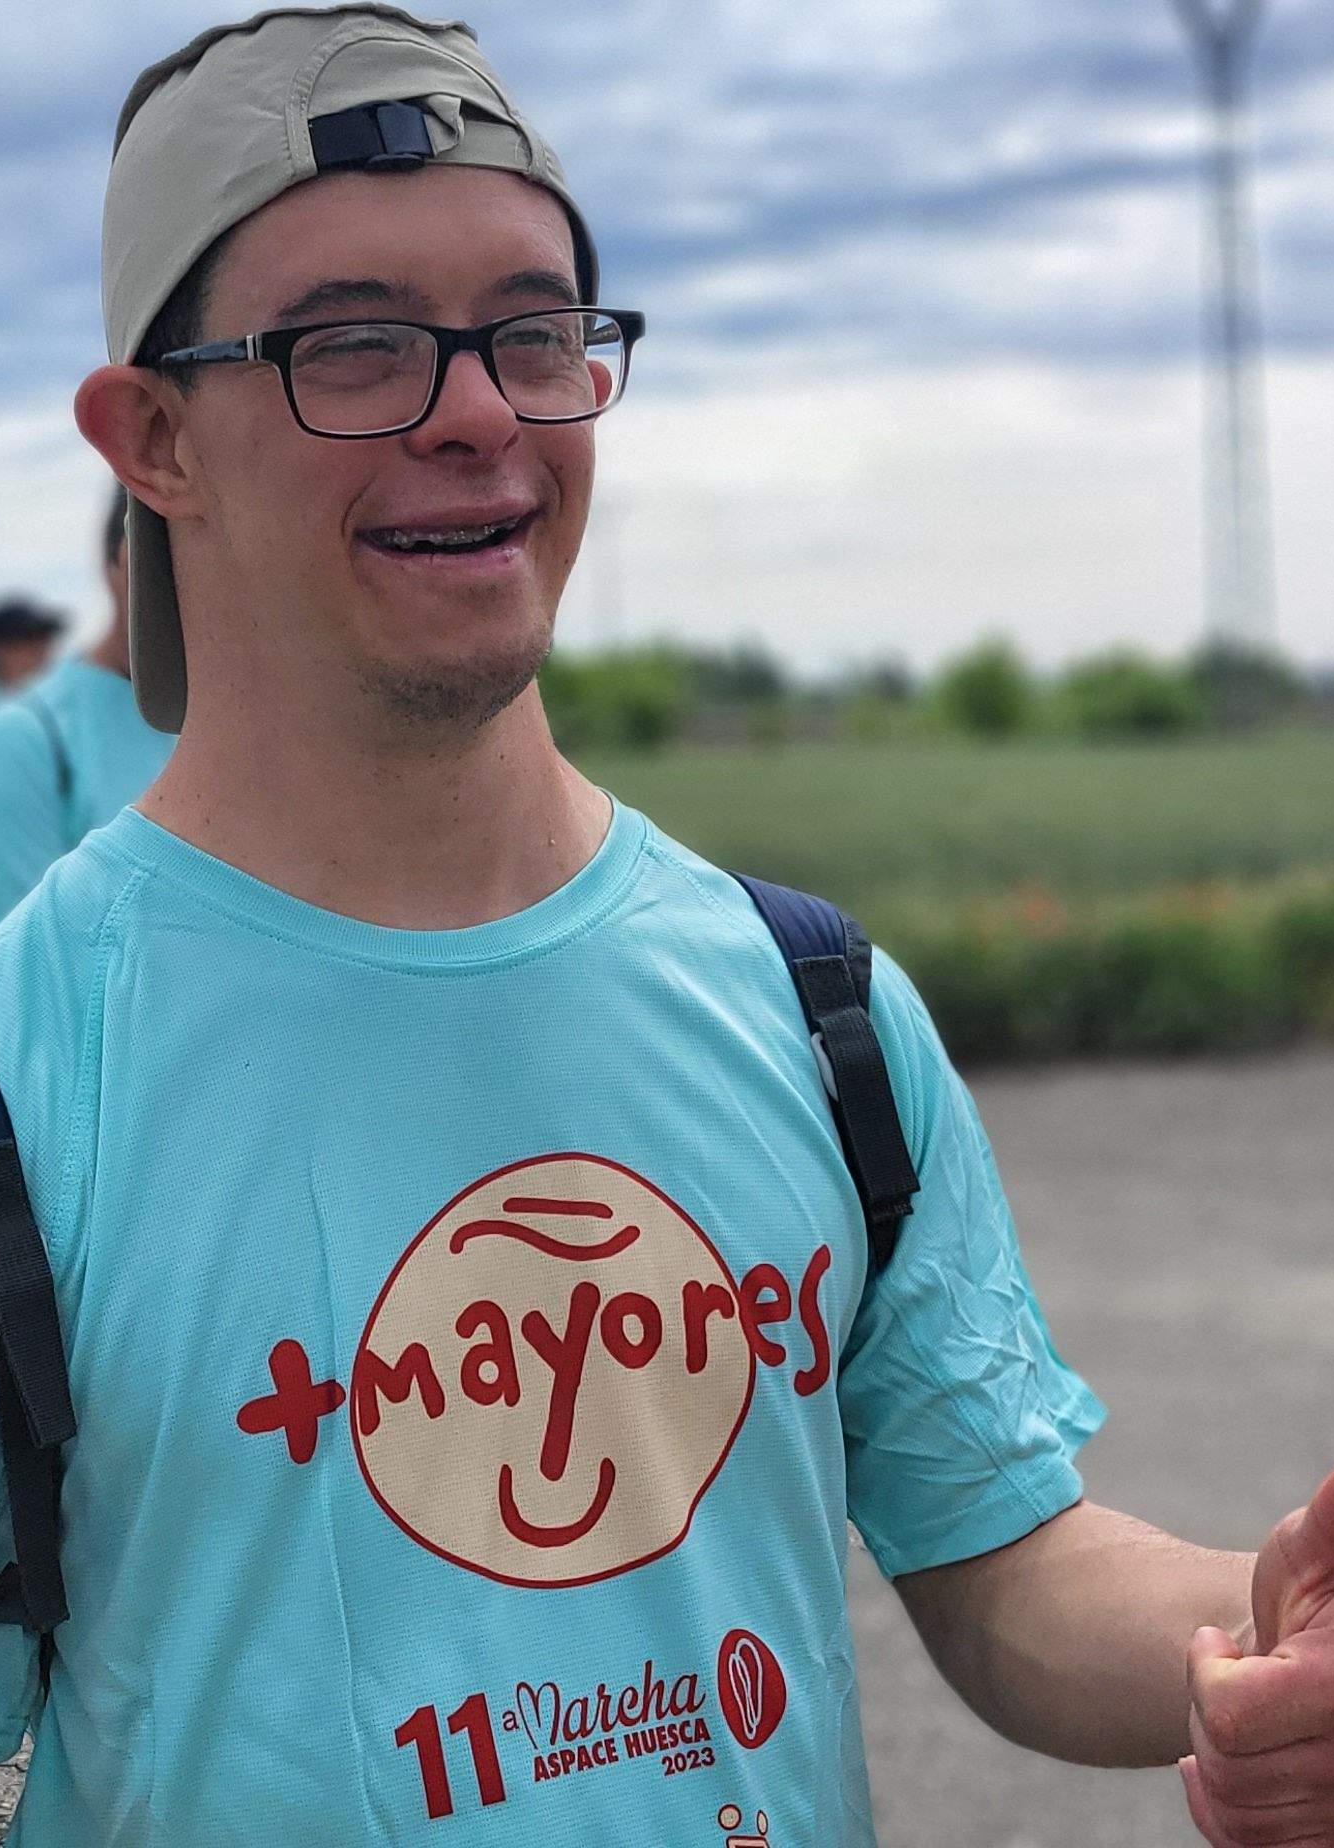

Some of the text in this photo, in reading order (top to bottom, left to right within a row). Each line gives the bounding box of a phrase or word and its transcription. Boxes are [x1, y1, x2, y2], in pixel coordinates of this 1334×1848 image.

[515, 1659, 706, 1750] Marcha
[533, 1717, 711, 1783] ASPACE HUESCA
[660, 1746, 716, 1777] 2023
